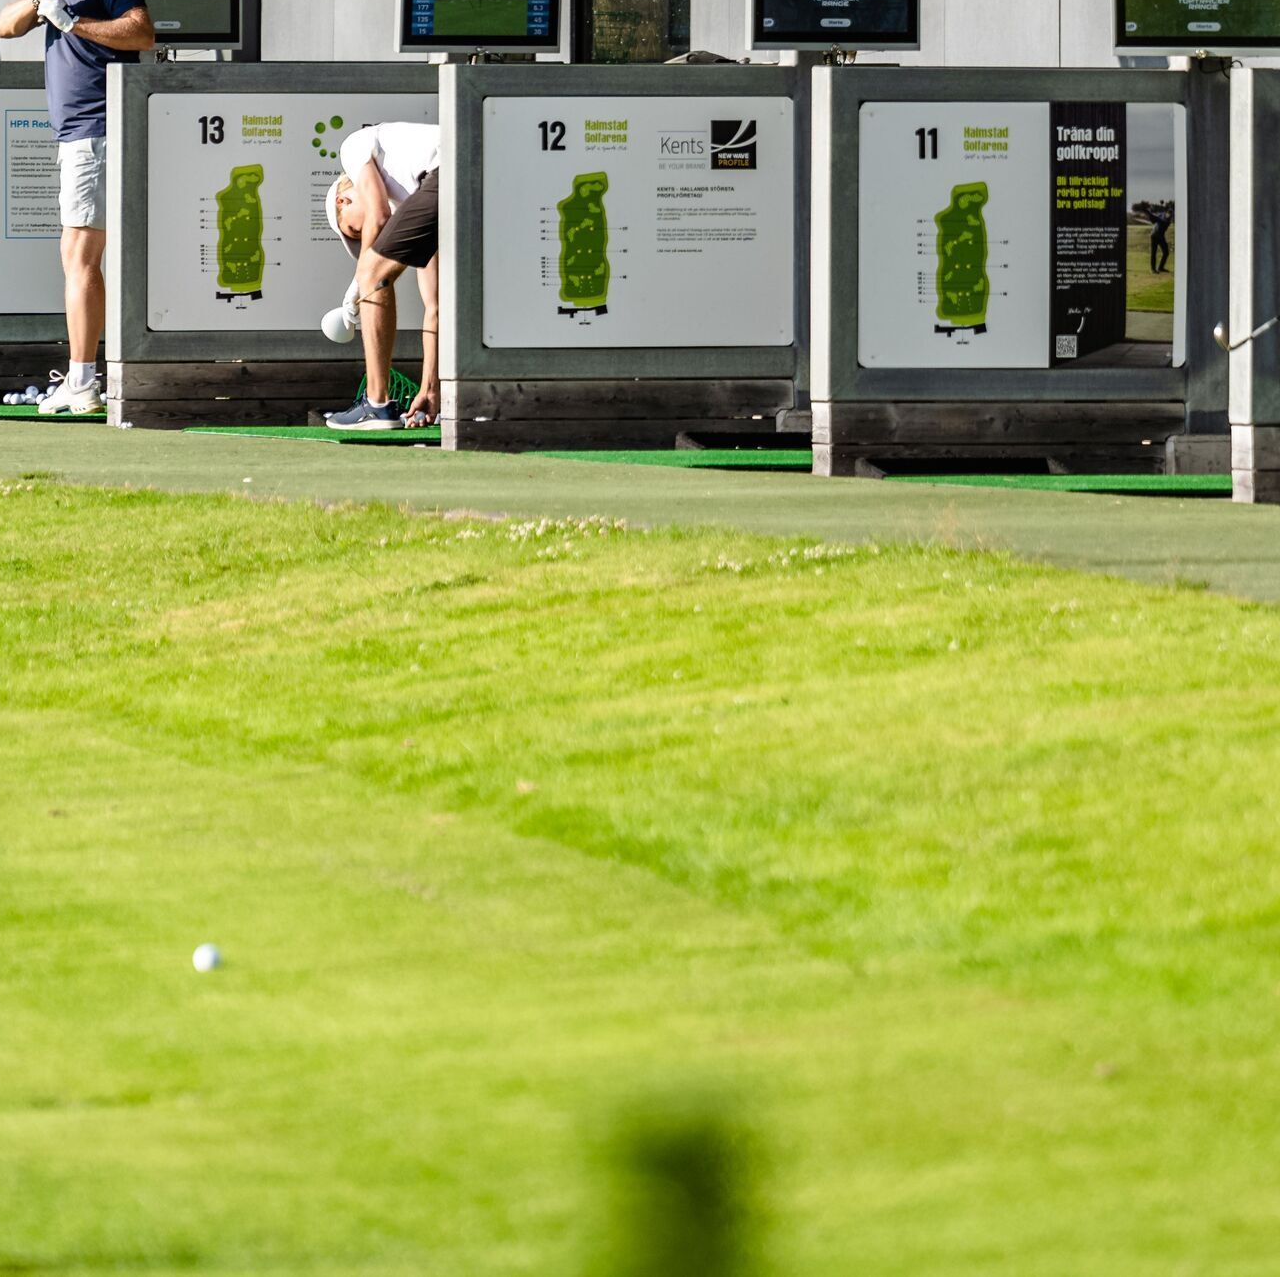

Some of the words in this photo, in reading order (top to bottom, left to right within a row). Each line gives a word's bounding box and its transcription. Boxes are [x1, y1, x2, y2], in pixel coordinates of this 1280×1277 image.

[10, 120, 29, 128] HPR
[242, 115, 282, 125] Halmstad
[585, 120, 628, 131] Halmstad
[198, 116, 224, 144] 13
[242, 127, 282, 137] Golfarena
[964, 127, 1008, 138] Halmstad
[1057, 126, 1092, 141] Träna
[1096, 126, 1114, 141] din
[538, 121, 566, 151] 12
[585, 133, 627, 143] Golfarena
[660, 137, 704, 155] Kents
[915, 128, 938, 159] 11
[964, 140, 1008, 151] Golfarena
[1057, 145, 1118, 162] golfkropp!
[1088, 188, 1109, 197] stark
[1057, 199, 1070, 209] bra
